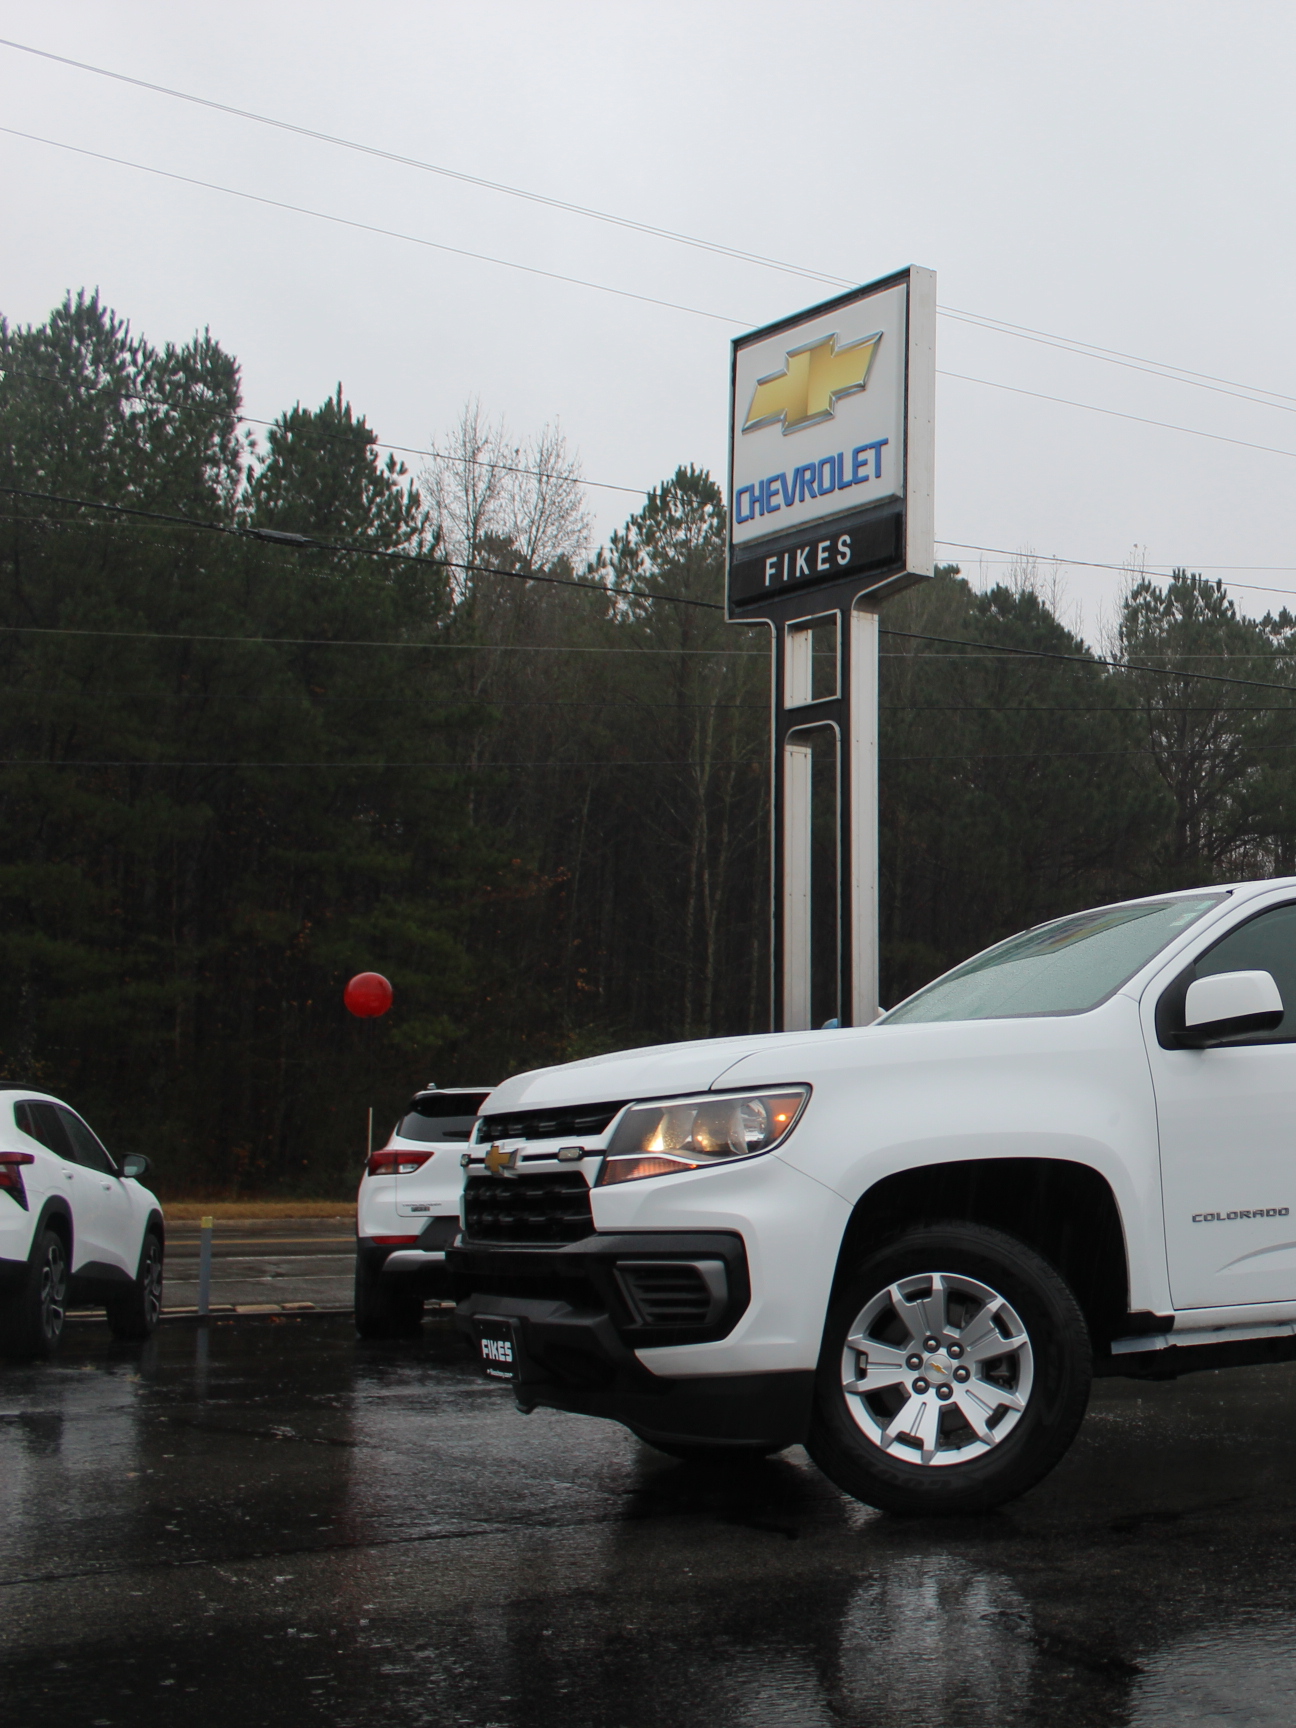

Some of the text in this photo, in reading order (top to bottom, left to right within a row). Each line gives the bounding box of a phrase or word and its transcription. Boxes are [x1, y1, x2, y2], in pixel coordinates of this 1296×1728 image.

[735, 437, 889, 525] CHEVROLET
[764, 534, 852, 587] FIKES
[1192, 1207, 1290, 1223] COLORADO
[481, 1338, 513, 1362] FIKES
